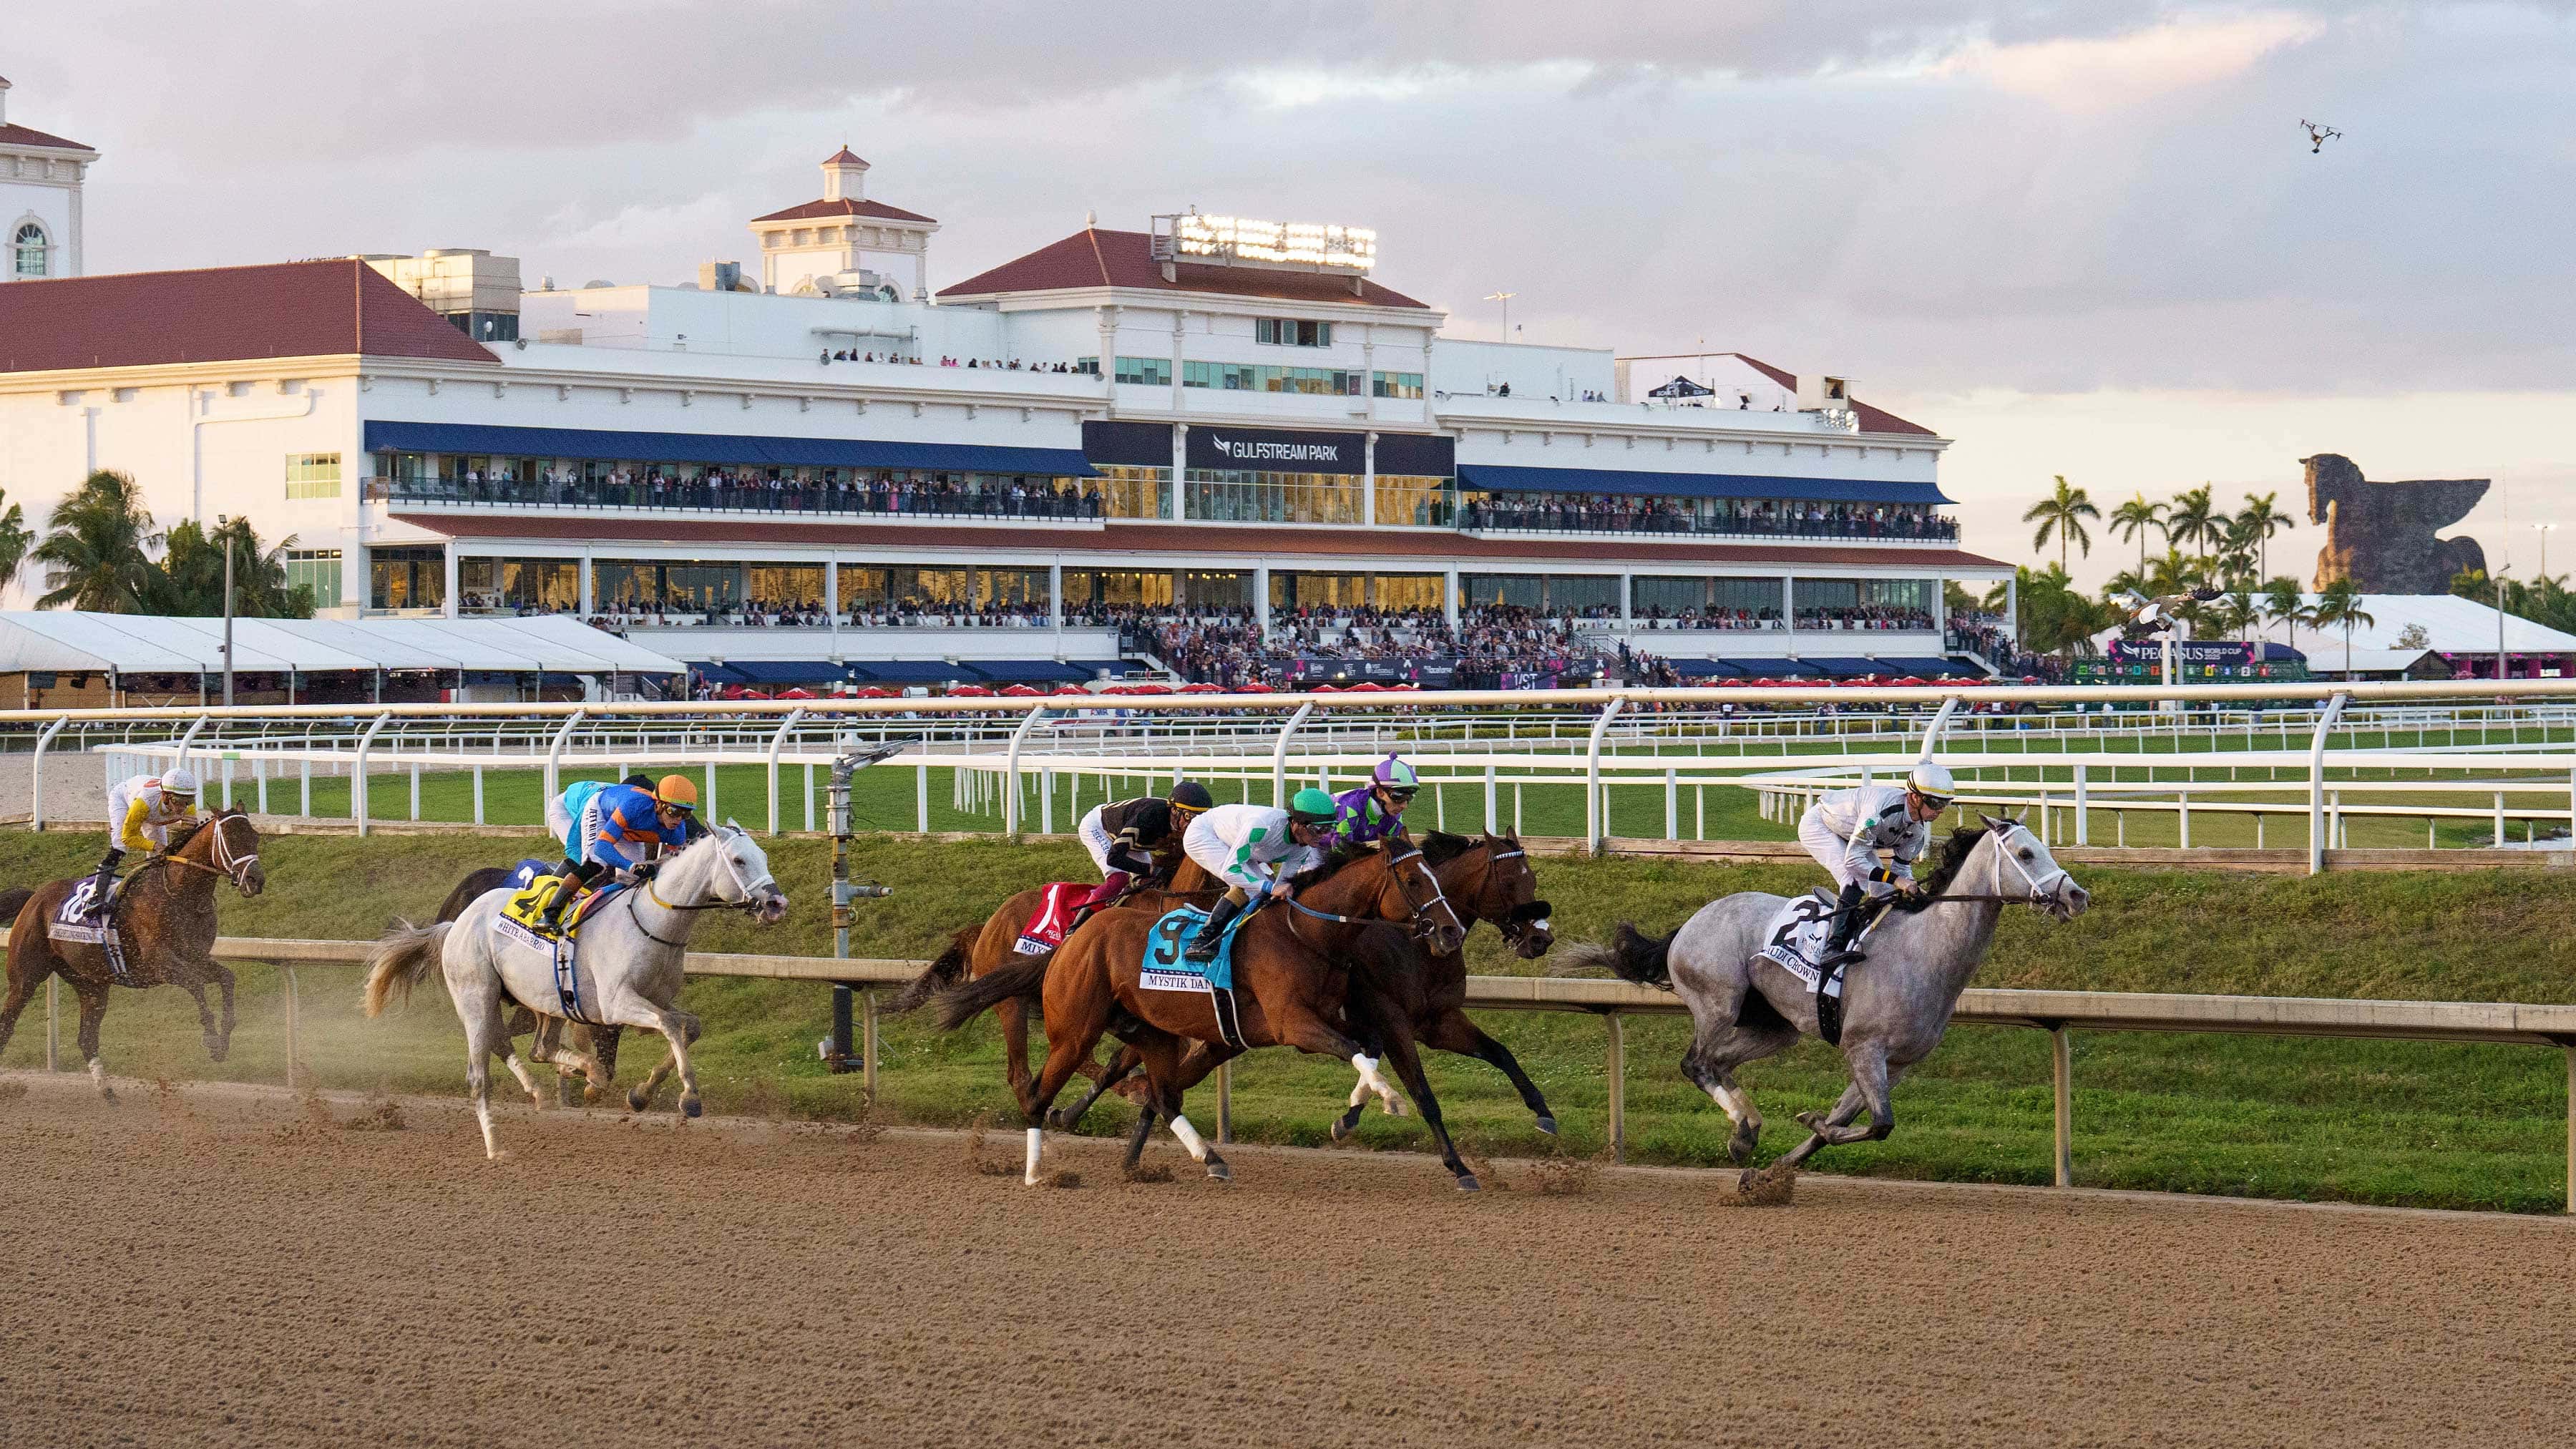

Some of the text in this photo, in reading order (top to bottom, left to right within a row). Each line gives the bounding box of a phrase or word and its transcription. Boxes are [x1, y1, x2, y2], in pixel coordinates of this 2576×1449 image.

[1233, 442, 1338, 461] GULFSTREAM PARK
[2141, 647, 2203, 660] PEASUS
[514, 880, 560, 919] 4
[1031, 884, 1060, 935] 1
[1770, 900, 1820, 947] 2
[1154, 915, 1190, 965] 9
[1148, 975, 1186, 988] MYSTIK
[1787, 957, 1820, 982] CROWN
